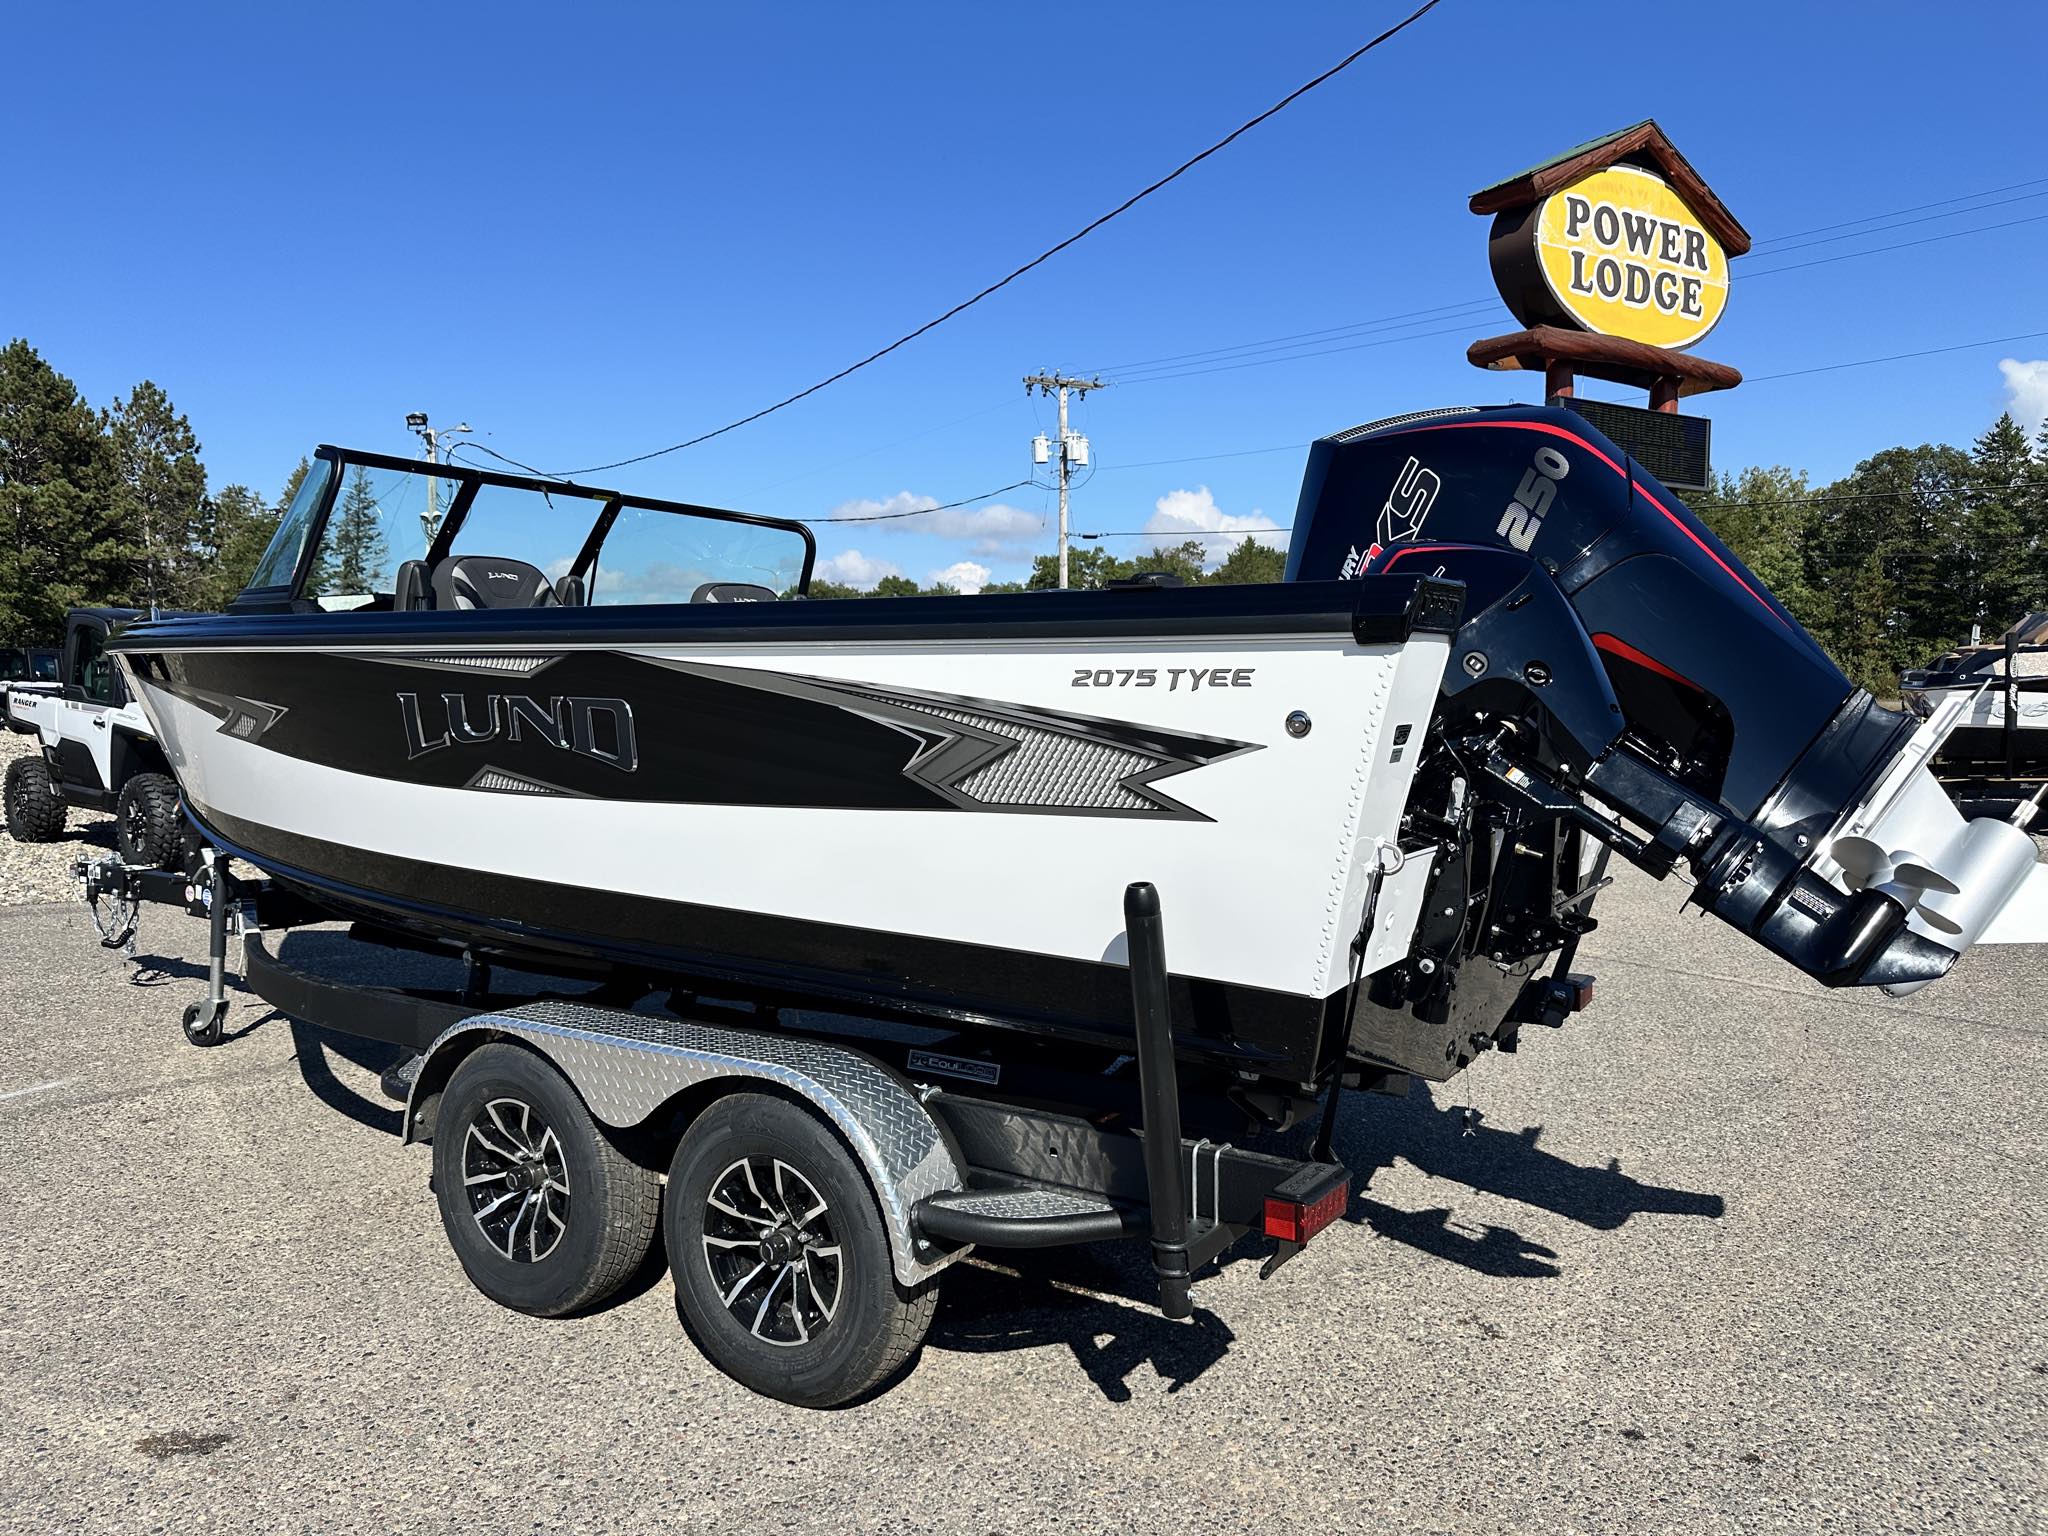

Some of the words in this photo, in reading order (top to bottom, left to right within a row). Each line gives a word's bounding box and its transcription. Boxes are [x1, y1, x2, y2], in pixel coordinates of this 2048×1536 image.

[1566, 196, 1708, 271] POWER
[1571, 250, 1702, 317] LODGE
[1496, 446, 1570, 552] 250
[487, 571, 519, 581] LUND
[13, 697, 38, 708] RANGER
[1071, 669, 1157, 687] 2075
[1167, 668, 1256, 692] TYEE
[396, 692, 639, 773] LUND
